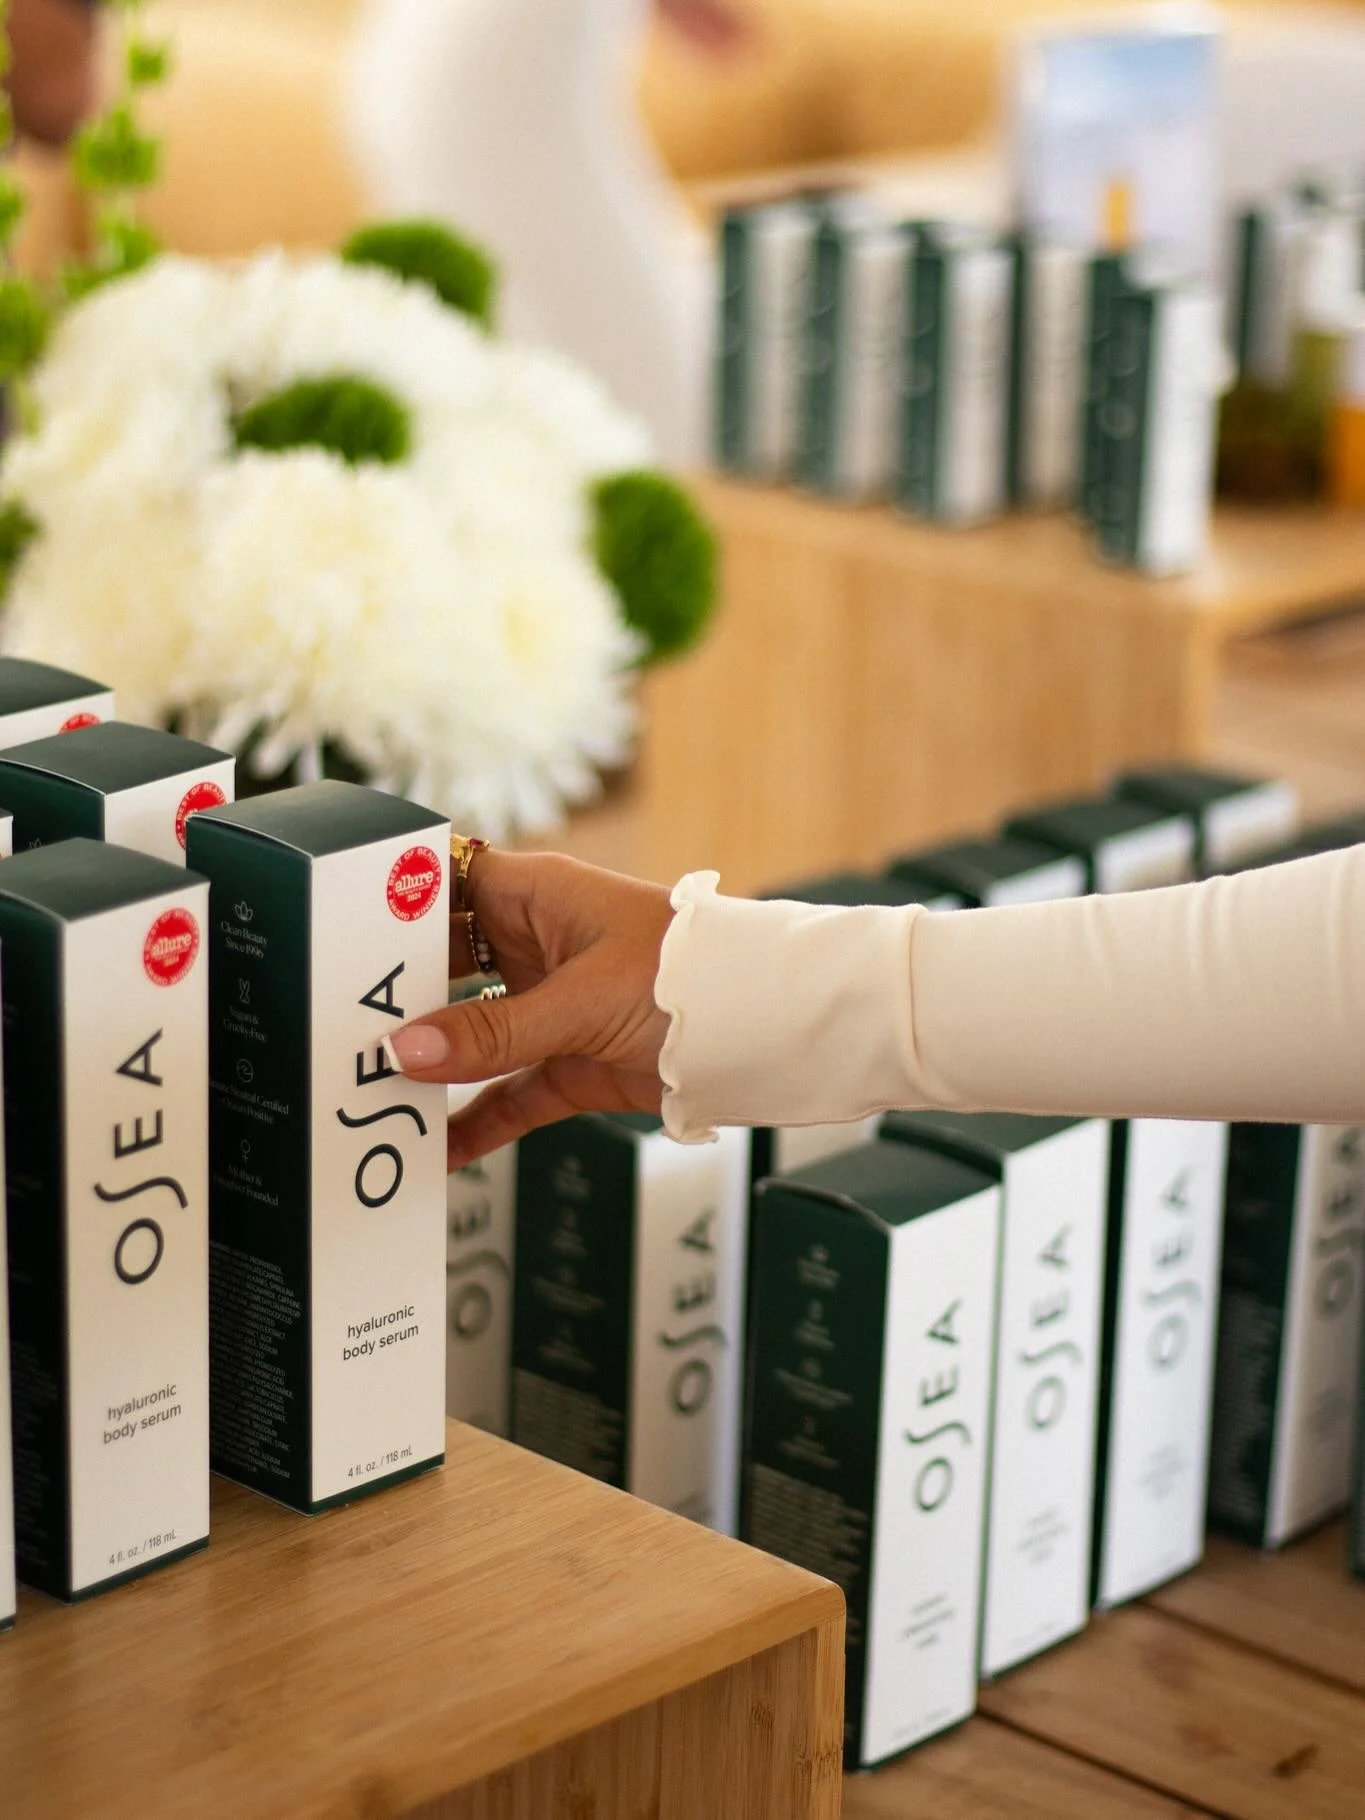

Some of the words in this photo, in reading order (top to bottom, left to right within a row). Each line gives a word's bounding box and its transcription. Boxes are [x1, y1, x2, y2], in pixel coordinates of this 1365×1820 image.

[388, 859, 403, 886] BEST
[404, 850, 415, 860] OF
[417, 847, 441, 873] BEAUTY
[395, 871, 434, 893] allure
[388, 899, 410, 921] AWARD
[412, 884, 440, 920] WINNER
[407, 892, 421, 903] 2024
[150, 932, 192, 958] allure
[336, 960, 427, 1208] OSEA
[93, 1027, 189, 1285] OSEA
[348, 1305, 415, 1339] hyaluronic
[657, 1205, 729, 1417] OSEA
[1019, 1222, 1085, 1433] OSEA
[343, 1340, 376, 1361] body
[379, 1325, 419, 1348] serum
[108, 1384, 177, 1421] hyaluronic
[903, 1297, 972, 1513] OSEA
[103, 1422, 138, 1445] body
[141, 1404, 182, 1429] serum
[348, 1467, 354, 1477] 4
[366, 1461, 379, 1472] oz.
[386, 1450, 399, 1464] 118
[400, 1444, 413, 1458] mL
[109, 1554, 115, 1565] 4
[149, 1535, 162, 1549] 118
[164, 1529, 177, 1544] mL
